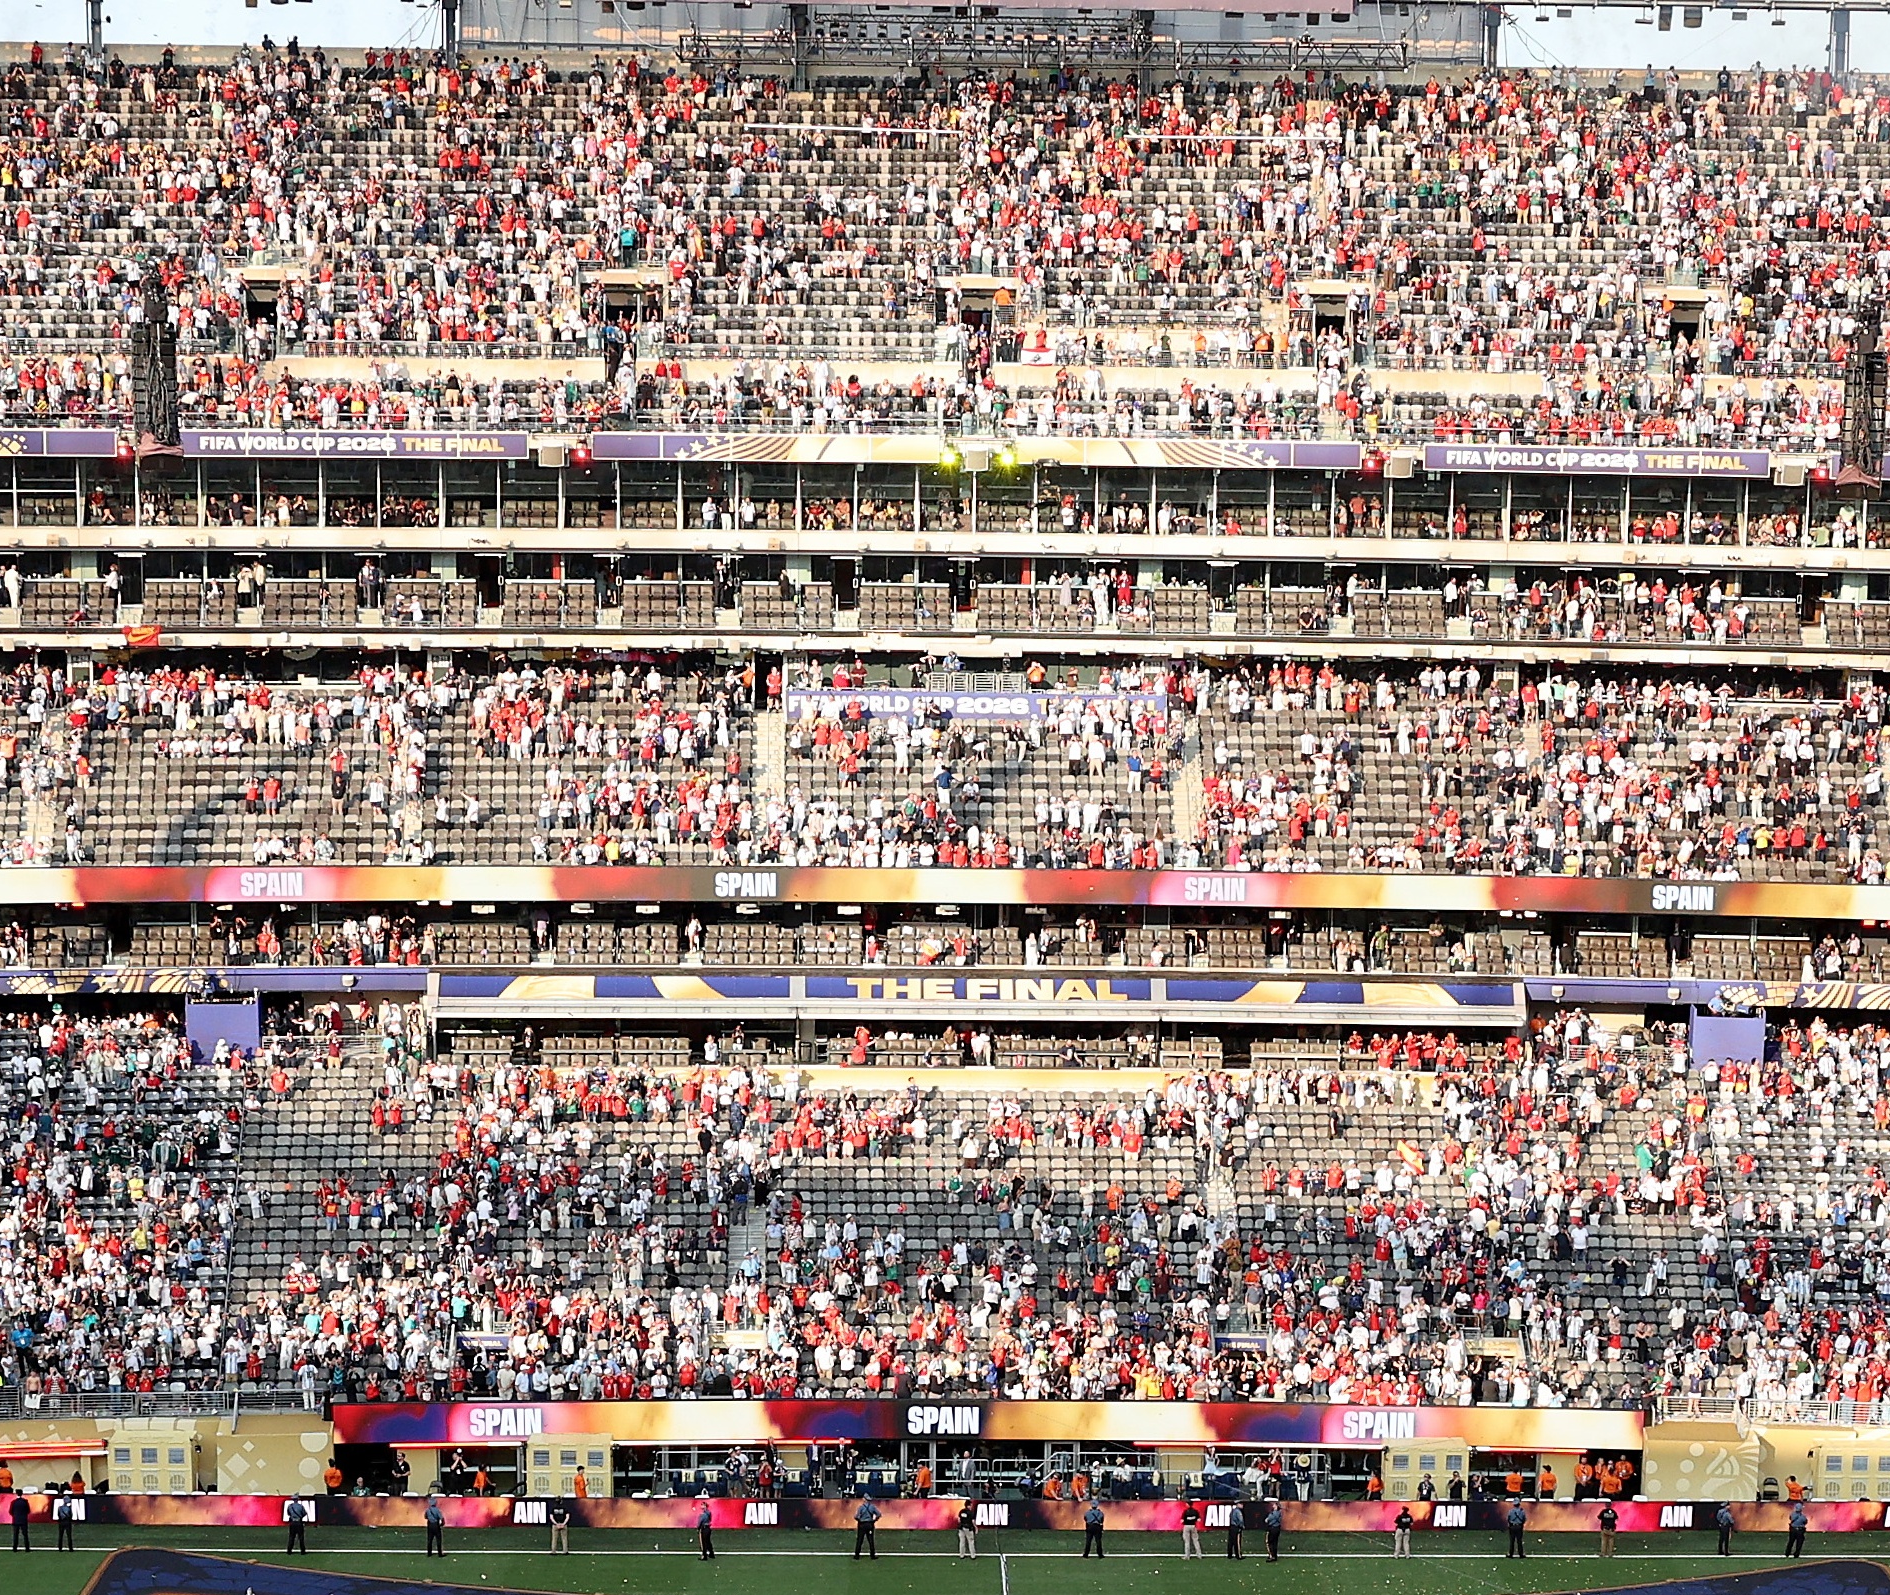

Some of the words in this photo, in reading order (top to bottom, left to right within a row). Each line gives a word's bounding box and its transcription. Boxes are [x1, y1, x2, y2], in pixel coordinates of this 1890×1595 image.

[200, 437, 236, 450] FIFA
[238, 437, 299, 451] WORLD
[301, 437, 335, 451] CUP
[338, 437, 396, 451] 2026
[402, 438, 442, 452] THE
[445, 438, 504, 452] FINAL
[1446, 450, 1483, 466] FIFA
[1485, 451, 1544, 468] WORLD
[1546, 453, 1580, 468] CUP
[1581, 454, 1639, 469] 2026
[1646, 455, 1686, 470] THE
[1688, 456, 1749, 472] FINAL
[957, 697, 1029, 713] 2026
[240, 872, 303, 898] SPAIN
[715, 873, 776, 897] SPAIN
[1184, 877, 1246, 902] SPAIN
[1652, 885, 1714, 910] SPAIN
[847, 978, 955, 1000] THE
[964, 978, 1127, 1001] FINAL
[470, 1408, 541, 1436] SPAIN
[907, 1405, 979, 1434] SPAIN
[1343, 1411, 1415, 1439] SPAIN
[514, 1501, 546, 1523] AIN
[745, 1502, 777, 1524] AIN
[976, 1503, 1008, 1525] AIN
[1434, 1505, 1466, 1526] AIN
[1660, 1506, 1692, 1527] AIN
